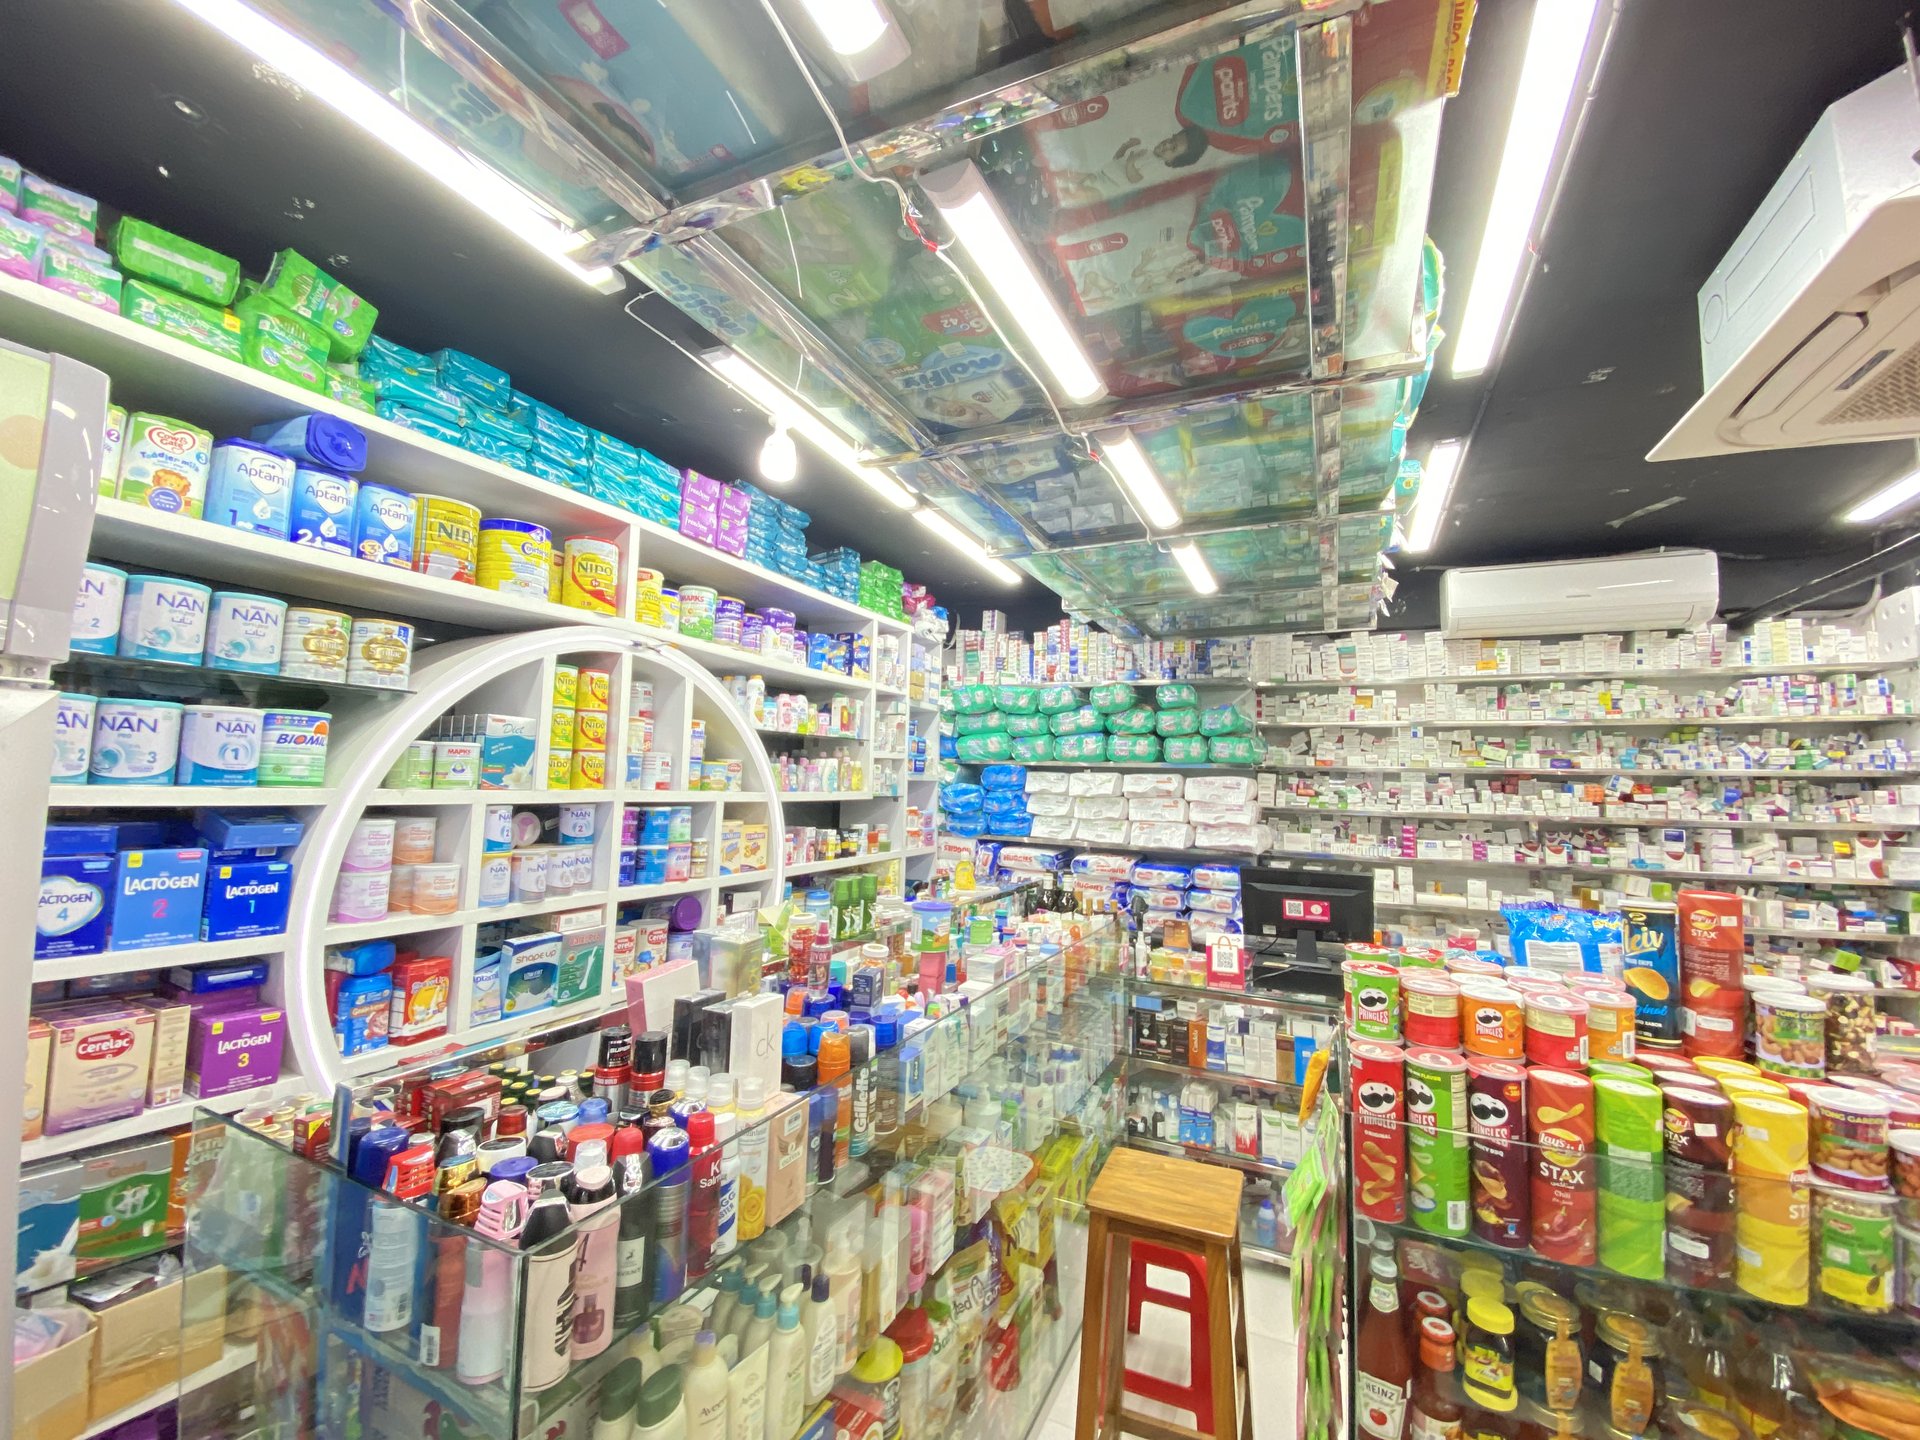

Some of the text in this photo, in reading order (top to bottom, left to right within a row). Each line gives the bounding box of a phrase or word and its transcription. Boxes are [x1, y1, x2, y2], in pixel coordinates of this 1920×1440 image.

[1260, 35, 1294, 121] Pampers
[1215, 67, 1239, 120] pants
[305, 484, 351, 506] Aptamil
[229, 509, 239, 526] 1
[370, 503, 413, 523] Aptamil
[296, 528, 313, 545] 2
[577, 560, 613, 576] NIDO
[156, 592, 205, 614] NAN
[231, 607, 279, 627] NAN
[100, 716, 158, 734] NAN
[216, 721, 257, 736] NAN
[502, 723, 526, 735] Diet
[276, 733, 326, 748] BIOMIL
[77, 748, 87, 763] 2
[146, 751, 158, 764] 3
[231, 747, 240, 761] 1
[124, 873, 200, 896] LACTOGEN
[225, 882, 279, 899] LACTOGEN
[57, 907, 69, 921] 4
[152, 898, 169, 919] 2
[249, 899, 257, 913] 1
[1359, 1007, 1389, 1025] PRINGLES
[1475, 1024, 1504, 1039] PRINGLES
[78, 1036, 132, 1055] Cerelac
[218, 1032, 272, 1055] LACTOGEN
[237, 1053, 250, 1068] 3
[853, 1066, 871, 1134] Gillette
[1540, 1161, 1585, 1185] STAX
[1365, 1382, 1396, 1402] HEINZ
